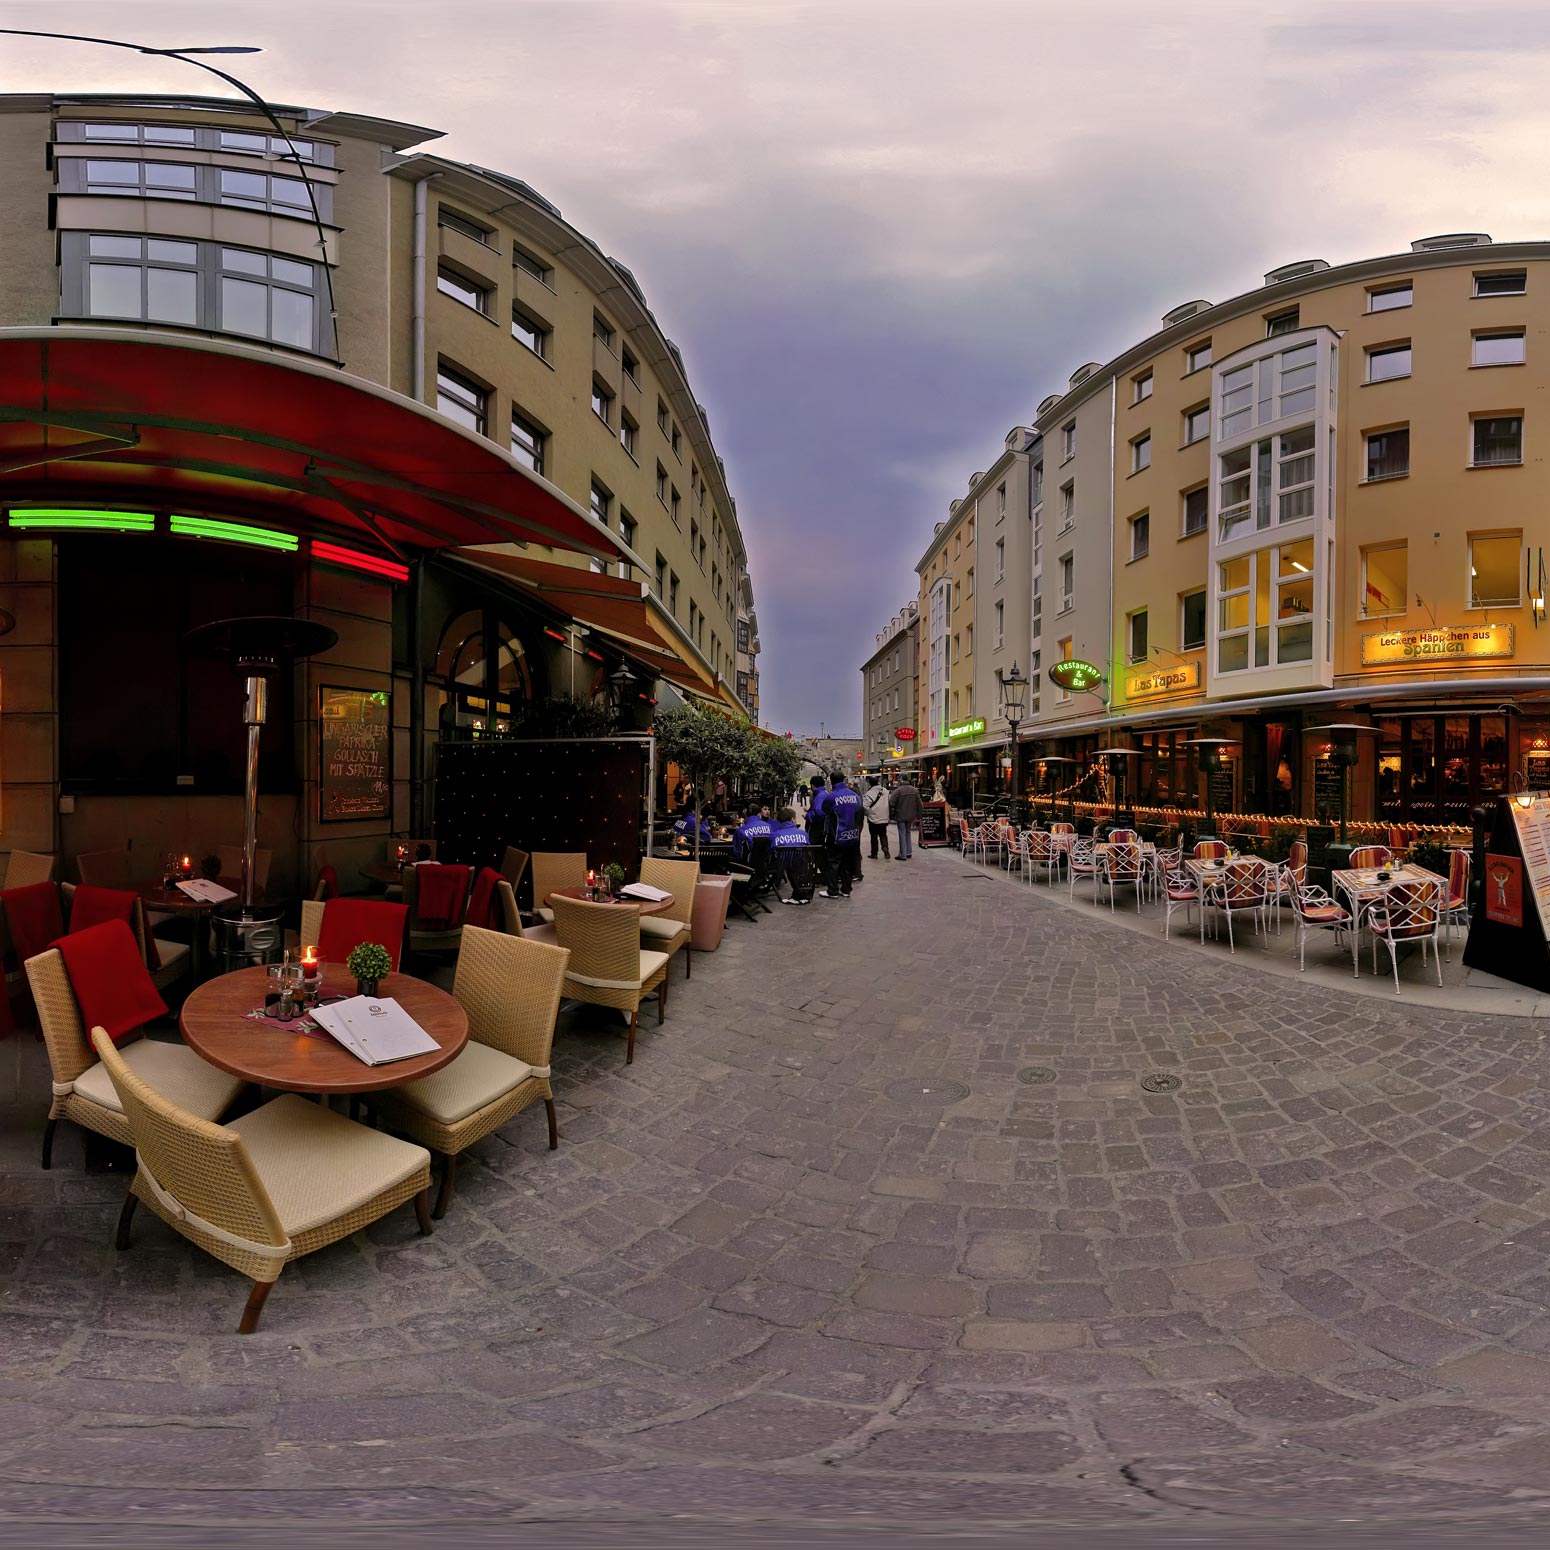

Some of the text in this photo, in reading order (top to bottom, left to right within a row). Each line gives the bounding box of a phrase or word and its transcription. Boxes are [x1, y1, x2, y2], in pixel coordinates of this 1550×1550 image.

[1380, 631, 1490, 647] Leckere Häppchen aus
[1403, 641, 1465, 657] Spanien
[1057, 661, 1101, 679] Restaurant
[1073, 678, 1086, 687] Bar
[1134, 672, 1187, 692] Las Tapas
[323, 722, 388, 738] UNGARISCHER
[334, 749, 379, 763] GOULASCH
[330, 763, 385, 778] MIT SPÄTZLE
[775, 833, 807, 846] РОССИЯ
